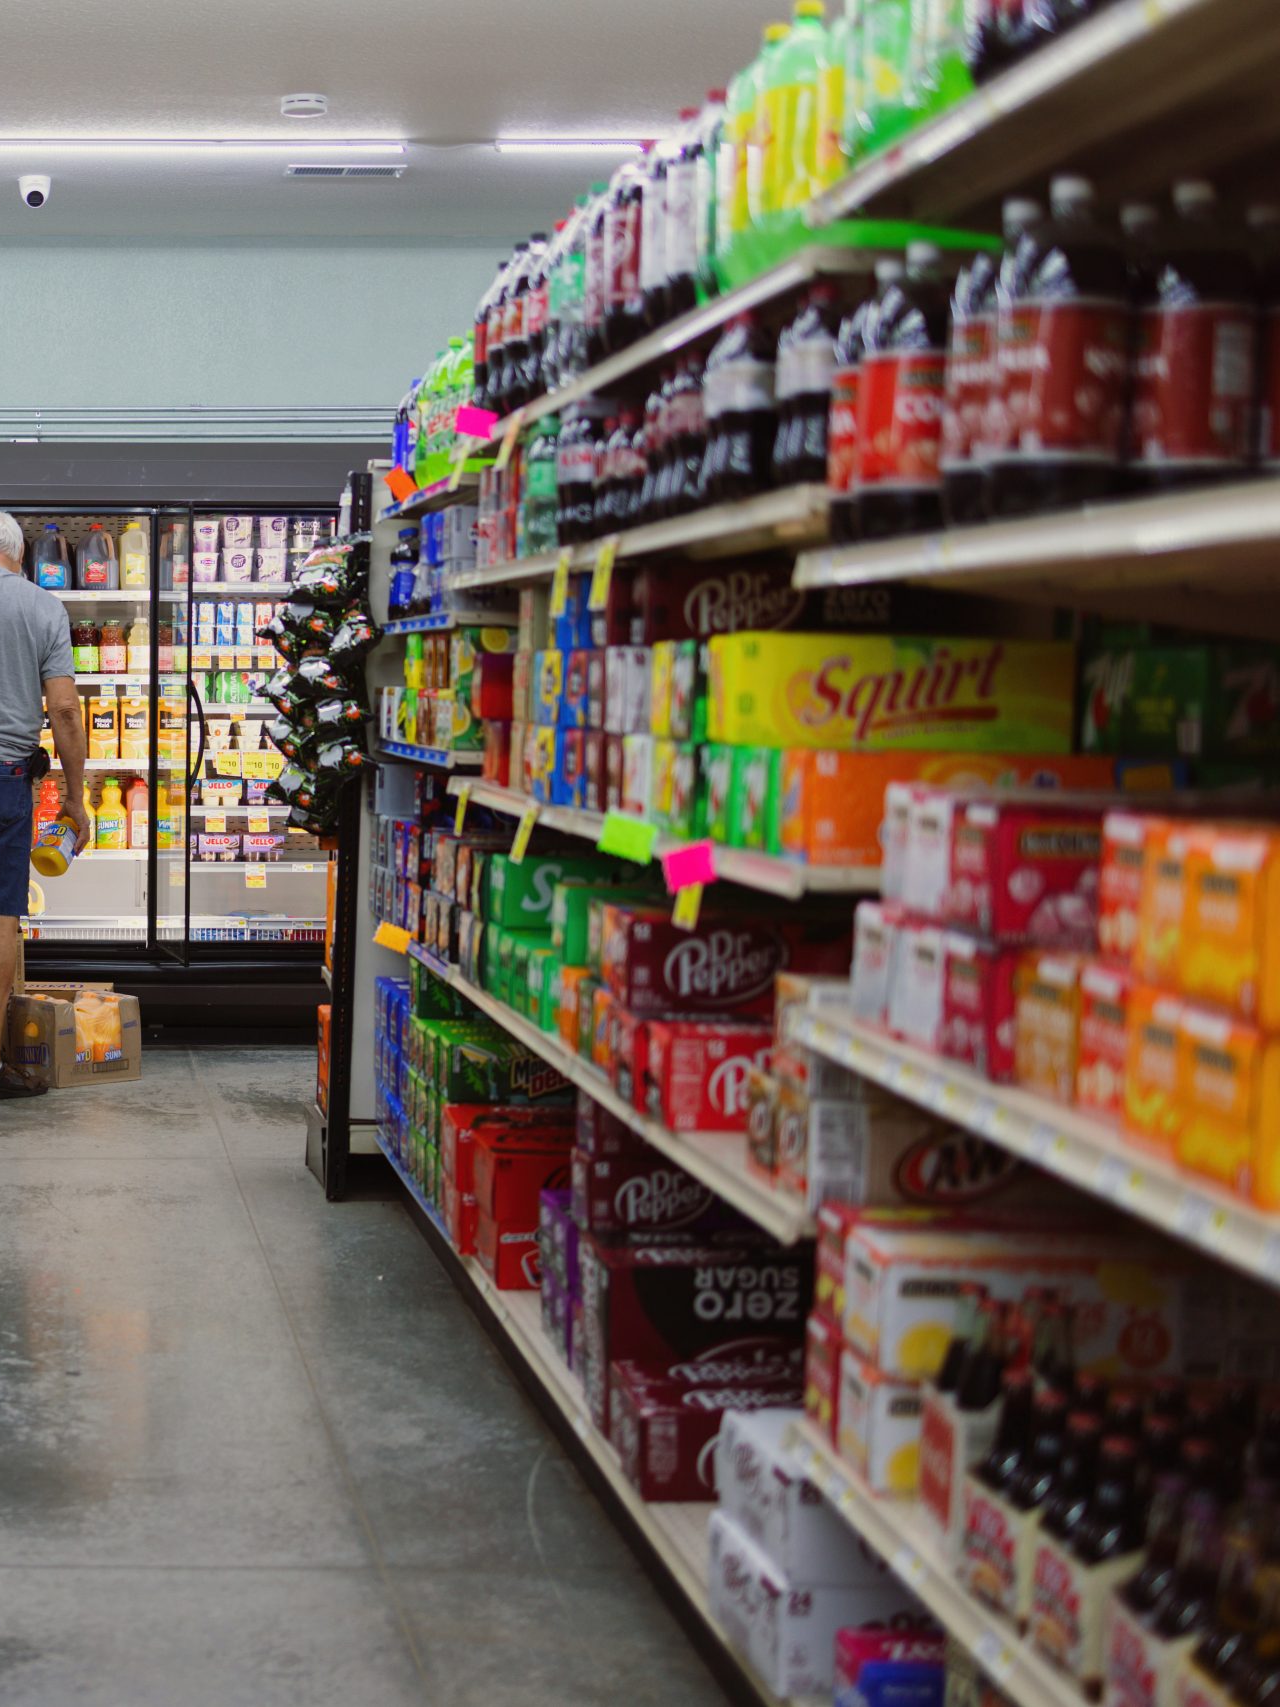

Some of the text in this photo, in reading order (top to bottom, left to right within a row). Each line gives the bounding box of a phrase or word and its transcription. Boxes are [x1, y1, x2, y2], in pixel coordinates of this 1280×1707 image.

[801, 643, 1004, 741] Squirt
[710, 930, 752, 962] Dr
[664, 938, 770, 996] Pepper
[652, 1170, 687, 1191] Dr
[615, 1177, 706, 1223] Pepper
[694, 1267, 799, 1289] SUGAR
[694, 1291, 799, 1320] zero
